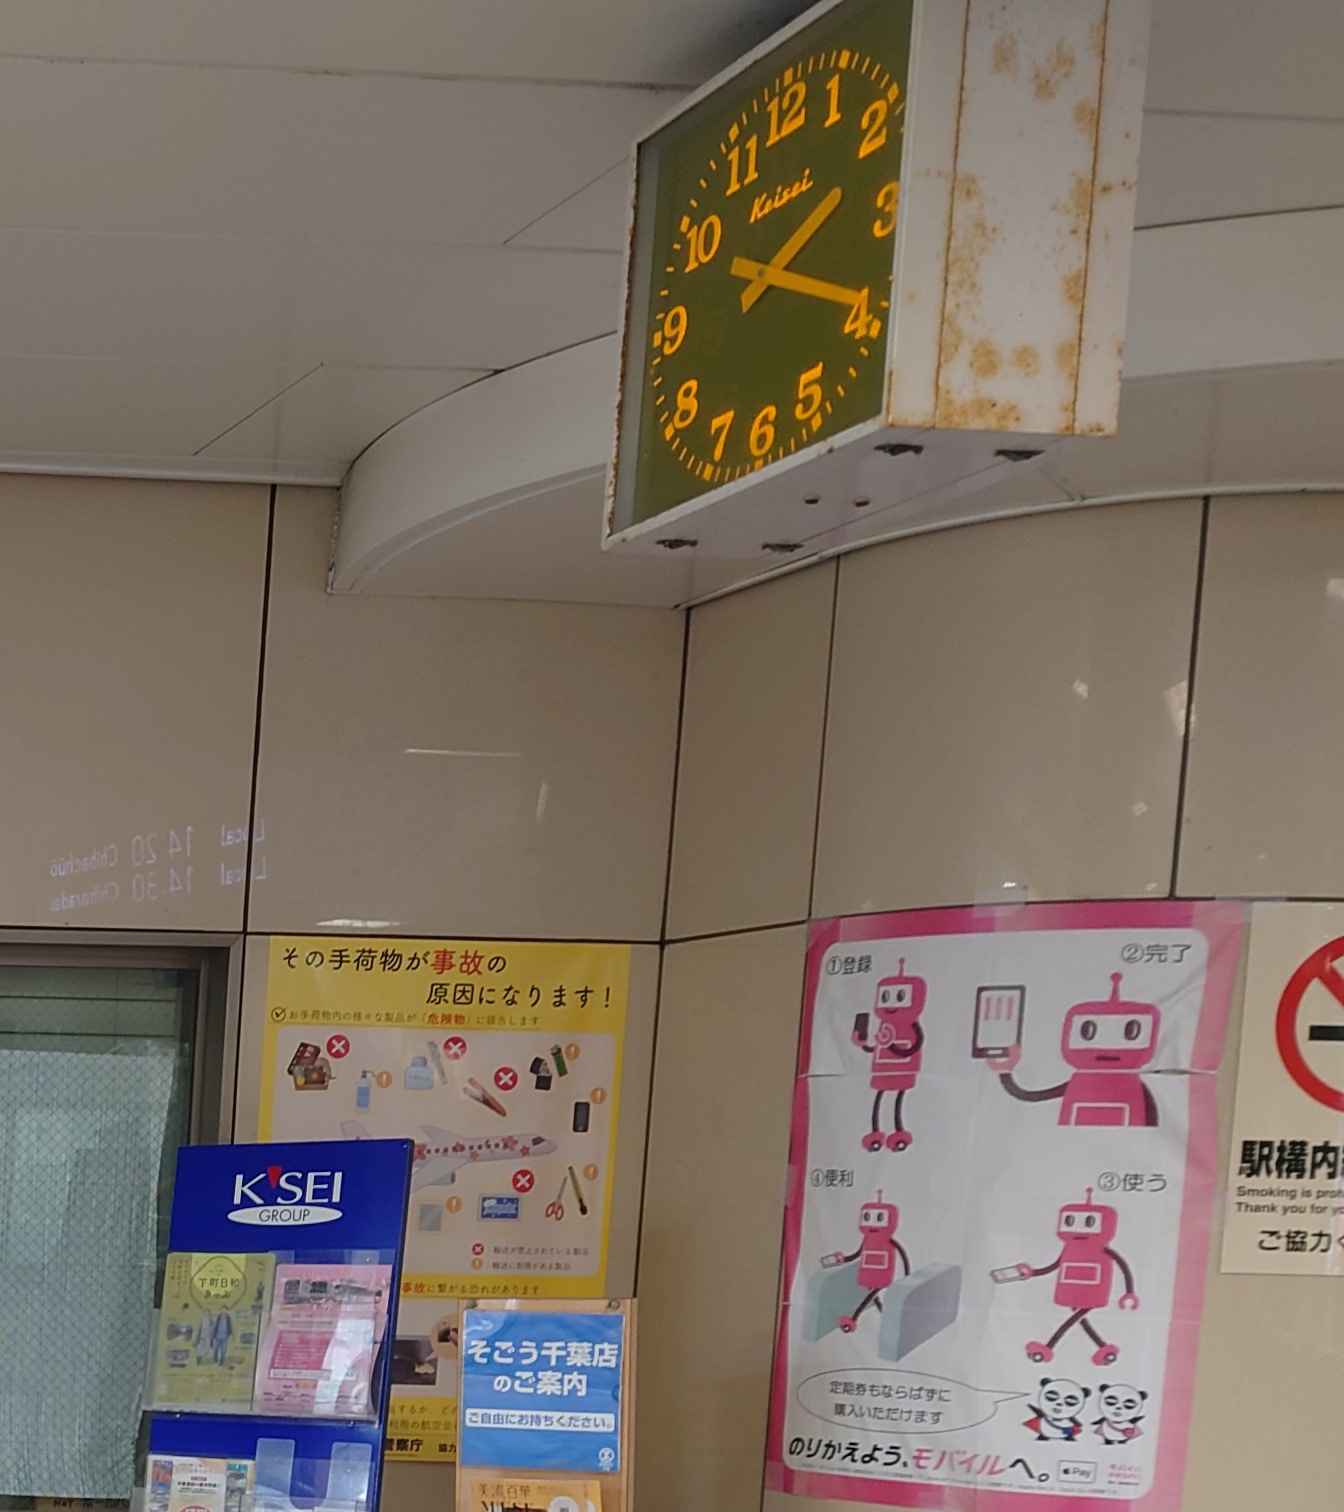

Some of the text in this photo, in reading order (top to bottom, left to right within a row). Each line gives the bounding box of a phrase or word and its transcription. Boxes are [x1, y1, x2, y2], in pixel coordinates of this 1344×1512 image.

[767, 82, 808, 147] 12
[824, 76, 842, 128] 1
[858, 99, 887, 160] 2
[725, 134, 759, 197] 11
[749, 169, 814, 224] Keisei
[873, 180, 899, 238] 3
[685, 214, 722, 274] 10
[663, 305, 688, 356] 9
[844, 287, 872, 341] 4
[676, 379, 699, 430] 8
[796, 362, 824, 421] 5
[711, 410, 735, 463] 7
[749, 405, 776, 457] 6
[282, 946, 507, 977] その手荷物が事故の
[1238, 1139, 1344, 1180] 駅構内
[258, 1207, 311, 1223] GROUP
[1236, 1186, 1297, 1200] Smoking
[1301, 1188, 1312, 1197] is
[1236, 1202, 1278, 1213] Thank
[1282, 1205, 1306, 1216] you
[1310, 1203, 1328, 1214] for
[467, 1340, 619, 1367] そごう千葉店
[493, 1371, 588, 1397] のご案内
[468, 1411, 612, 1430] ご自由にお持ちください。
[833, 1403, 944, 1425] 購入いただけます
